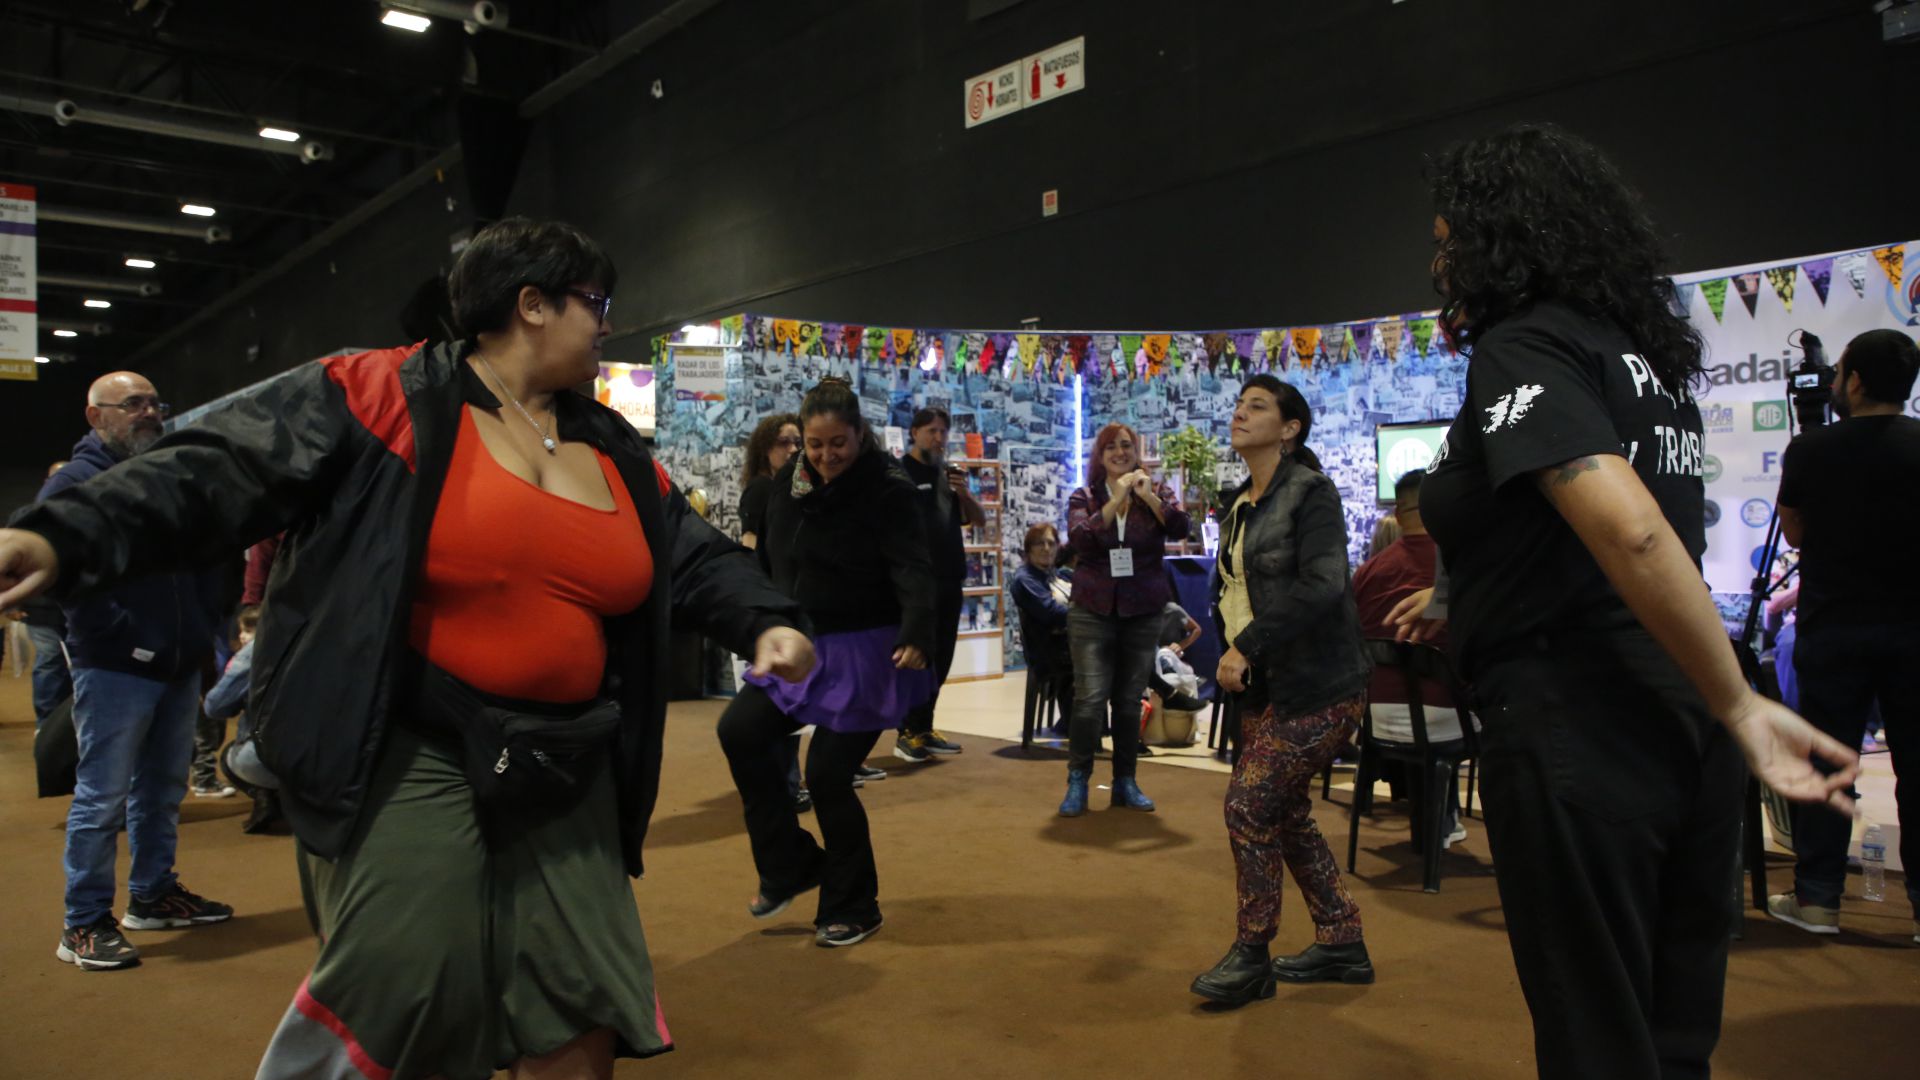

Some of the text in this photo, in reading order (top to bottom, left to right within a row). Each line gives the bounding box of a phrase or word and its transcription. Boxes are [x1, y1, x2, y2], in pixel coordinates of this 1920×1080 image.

[677, 360, 720, 369] RADAR DE LOS
[678, 370, 724, 378] TRABAJADORES
[1654, 425, 1705, 476] TRAB
